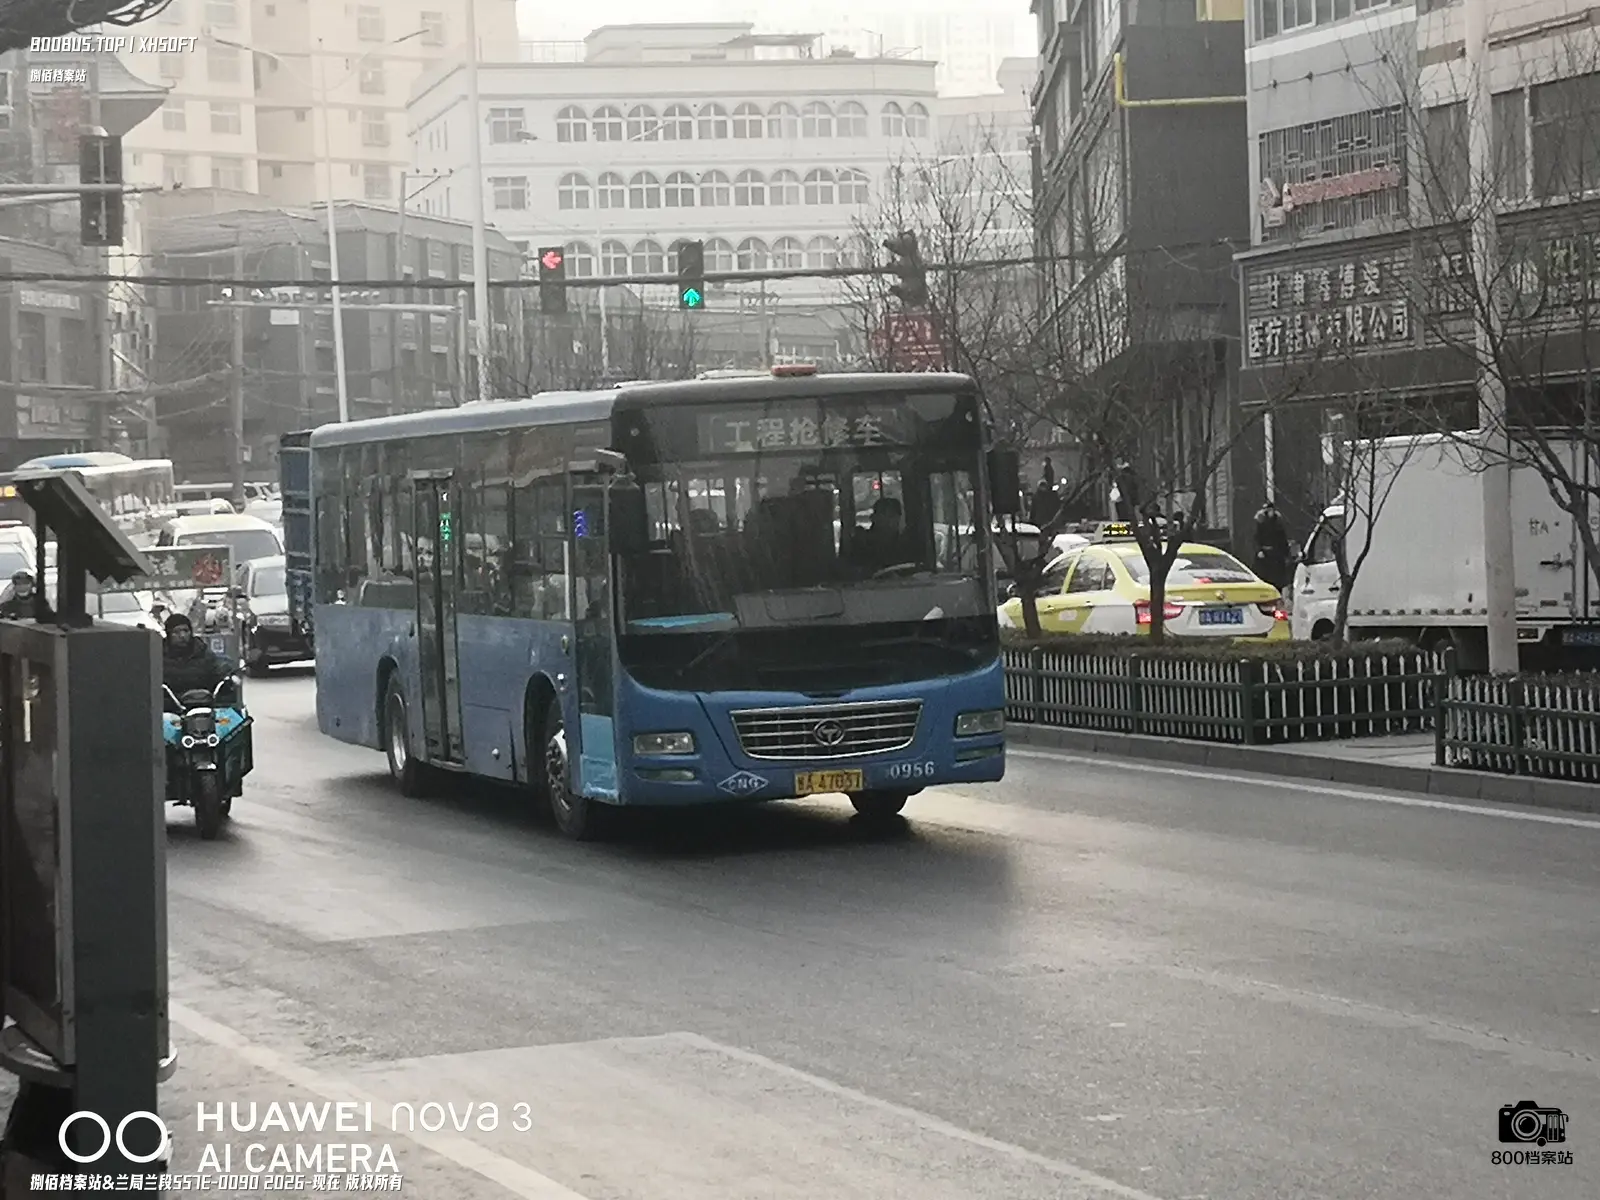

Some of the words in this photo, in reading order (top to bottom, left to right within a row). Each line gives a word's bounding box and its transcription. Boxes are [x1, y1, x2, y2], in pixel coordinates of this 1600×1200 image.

[725, 416, 882, 452] 工程抢修车
[727, 777, 760, 791] CNG
